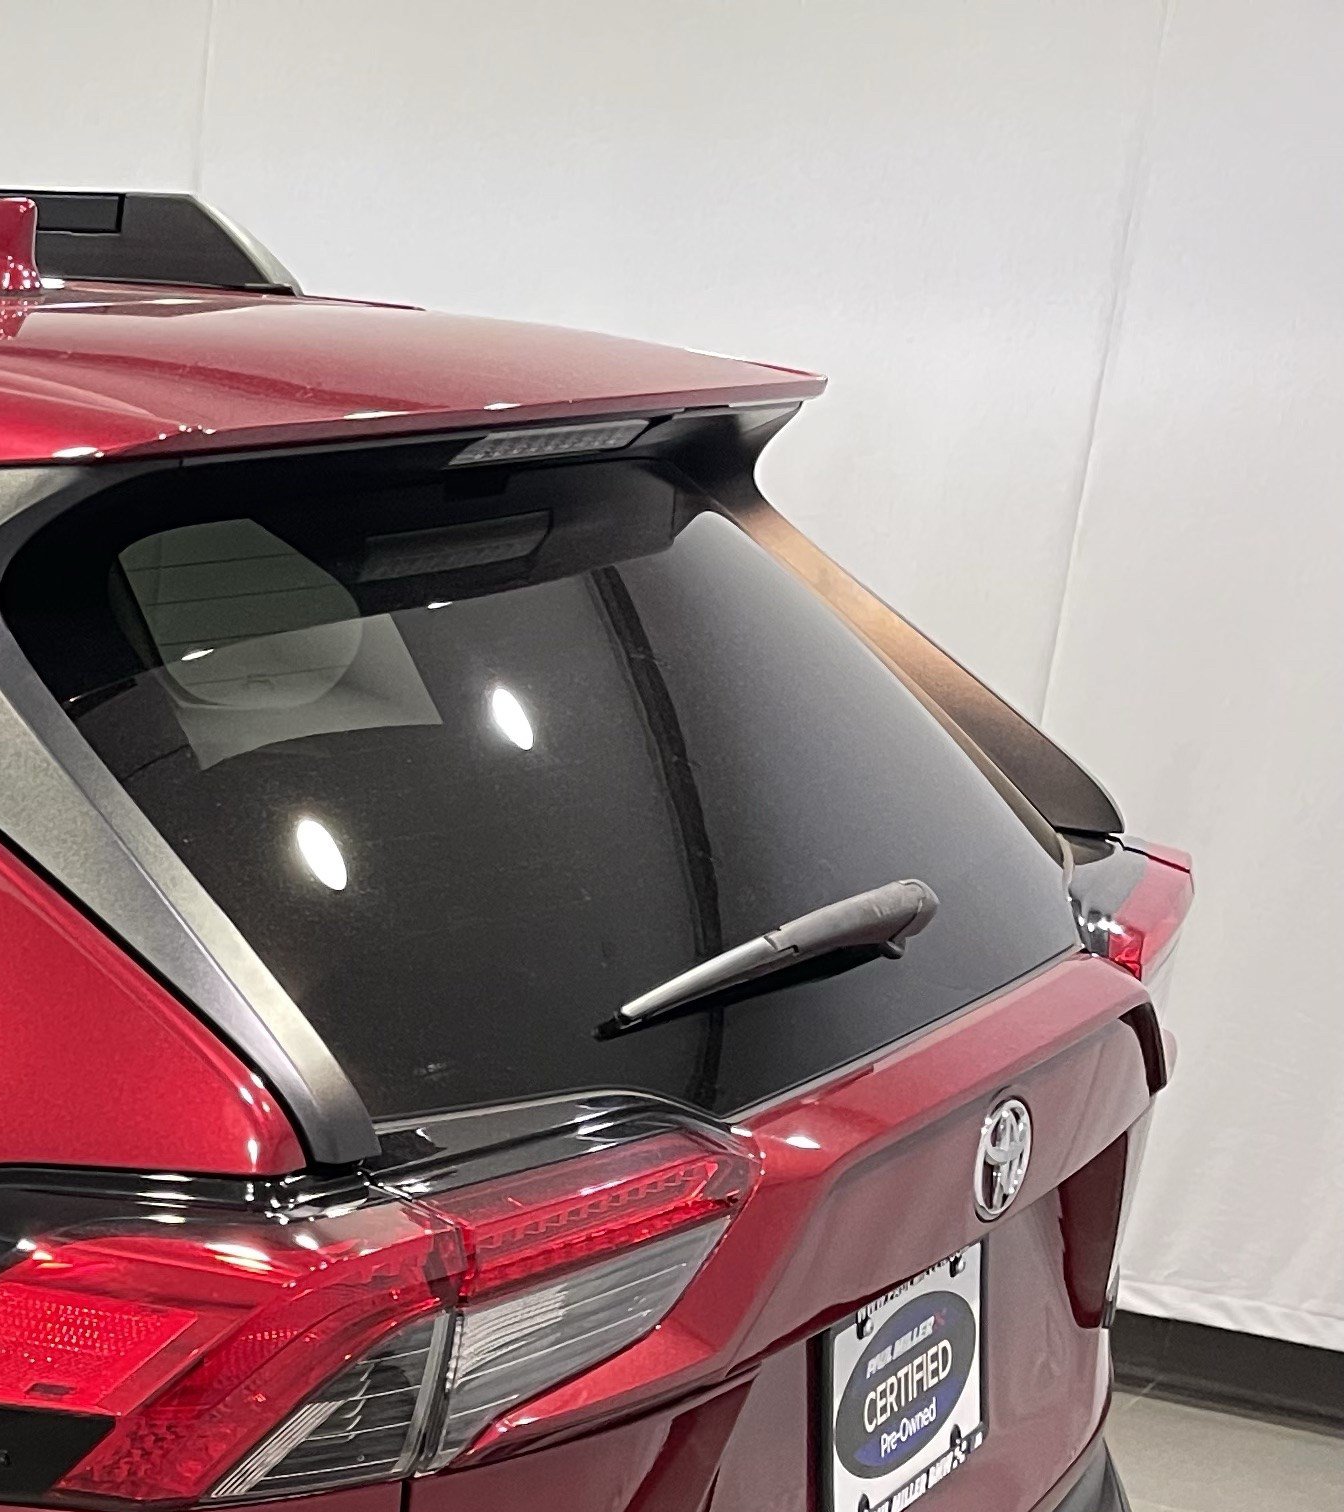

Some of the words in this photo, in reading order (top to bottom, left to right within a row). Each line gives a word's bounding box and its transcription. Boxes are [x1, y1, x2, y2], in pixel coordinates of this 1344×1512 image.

[892, 1316, 934, 1357] MILLER
[864, 1339, 952, 1433] CERTIFIED
[880, 1397, 937, 1458] Pre-Owned
